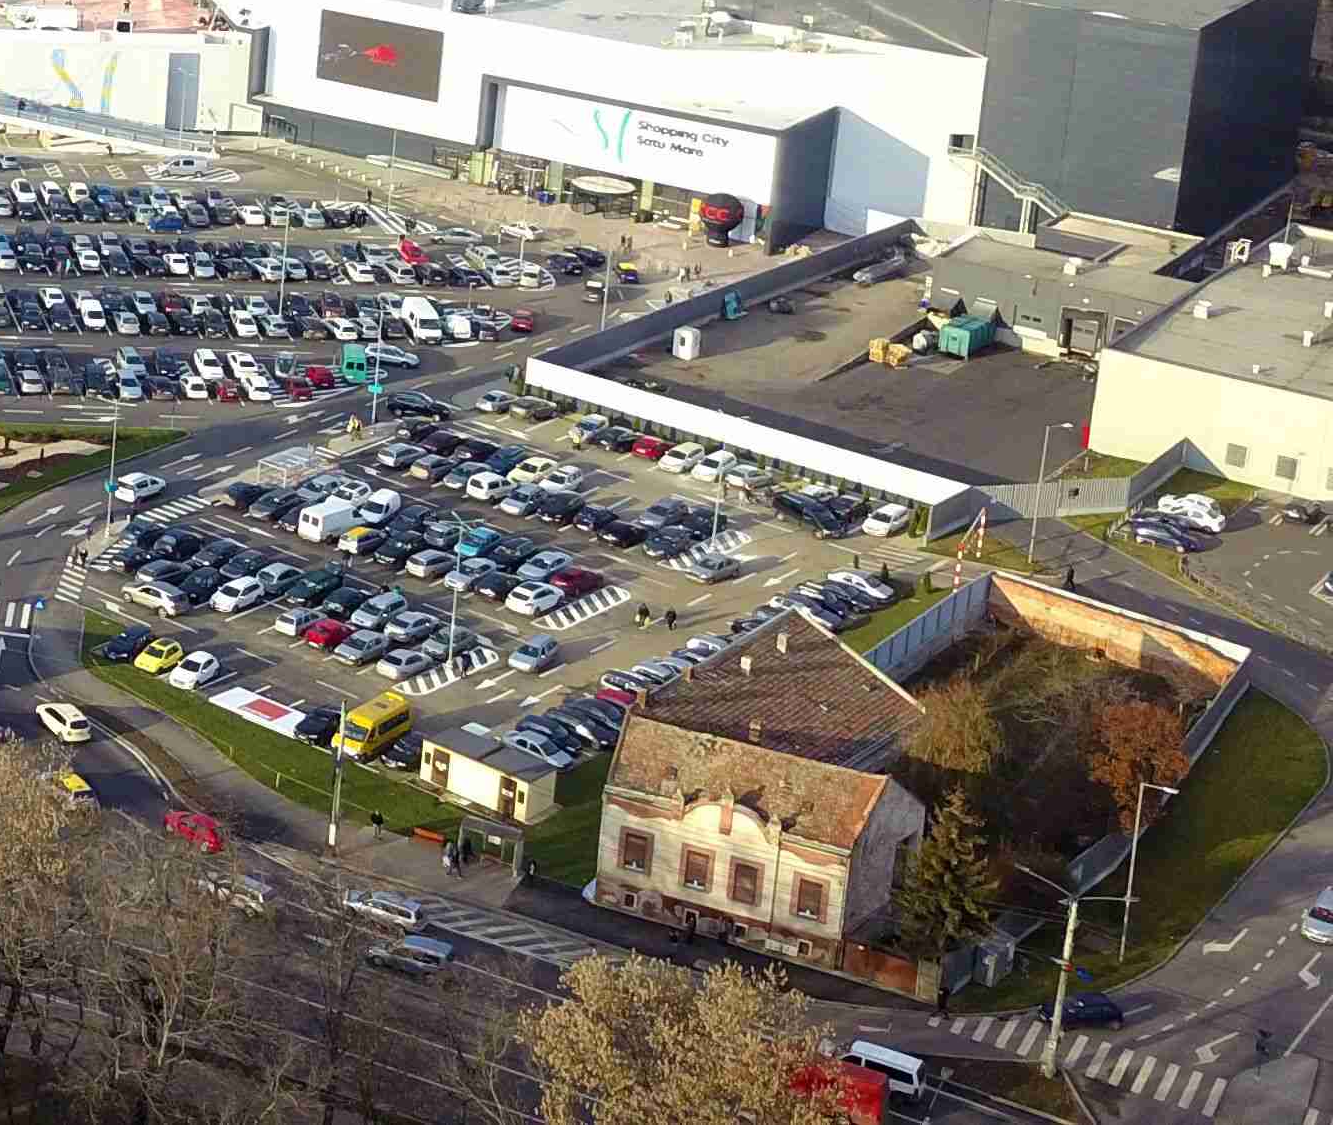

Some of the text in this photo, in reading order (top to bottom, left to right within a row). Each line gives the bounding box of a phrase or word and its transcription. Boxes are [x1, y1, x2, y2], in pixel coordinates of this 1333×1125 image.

[636, 134, 705, 158] Satu Mare
[637, 119, 730, 148] Shopping City
